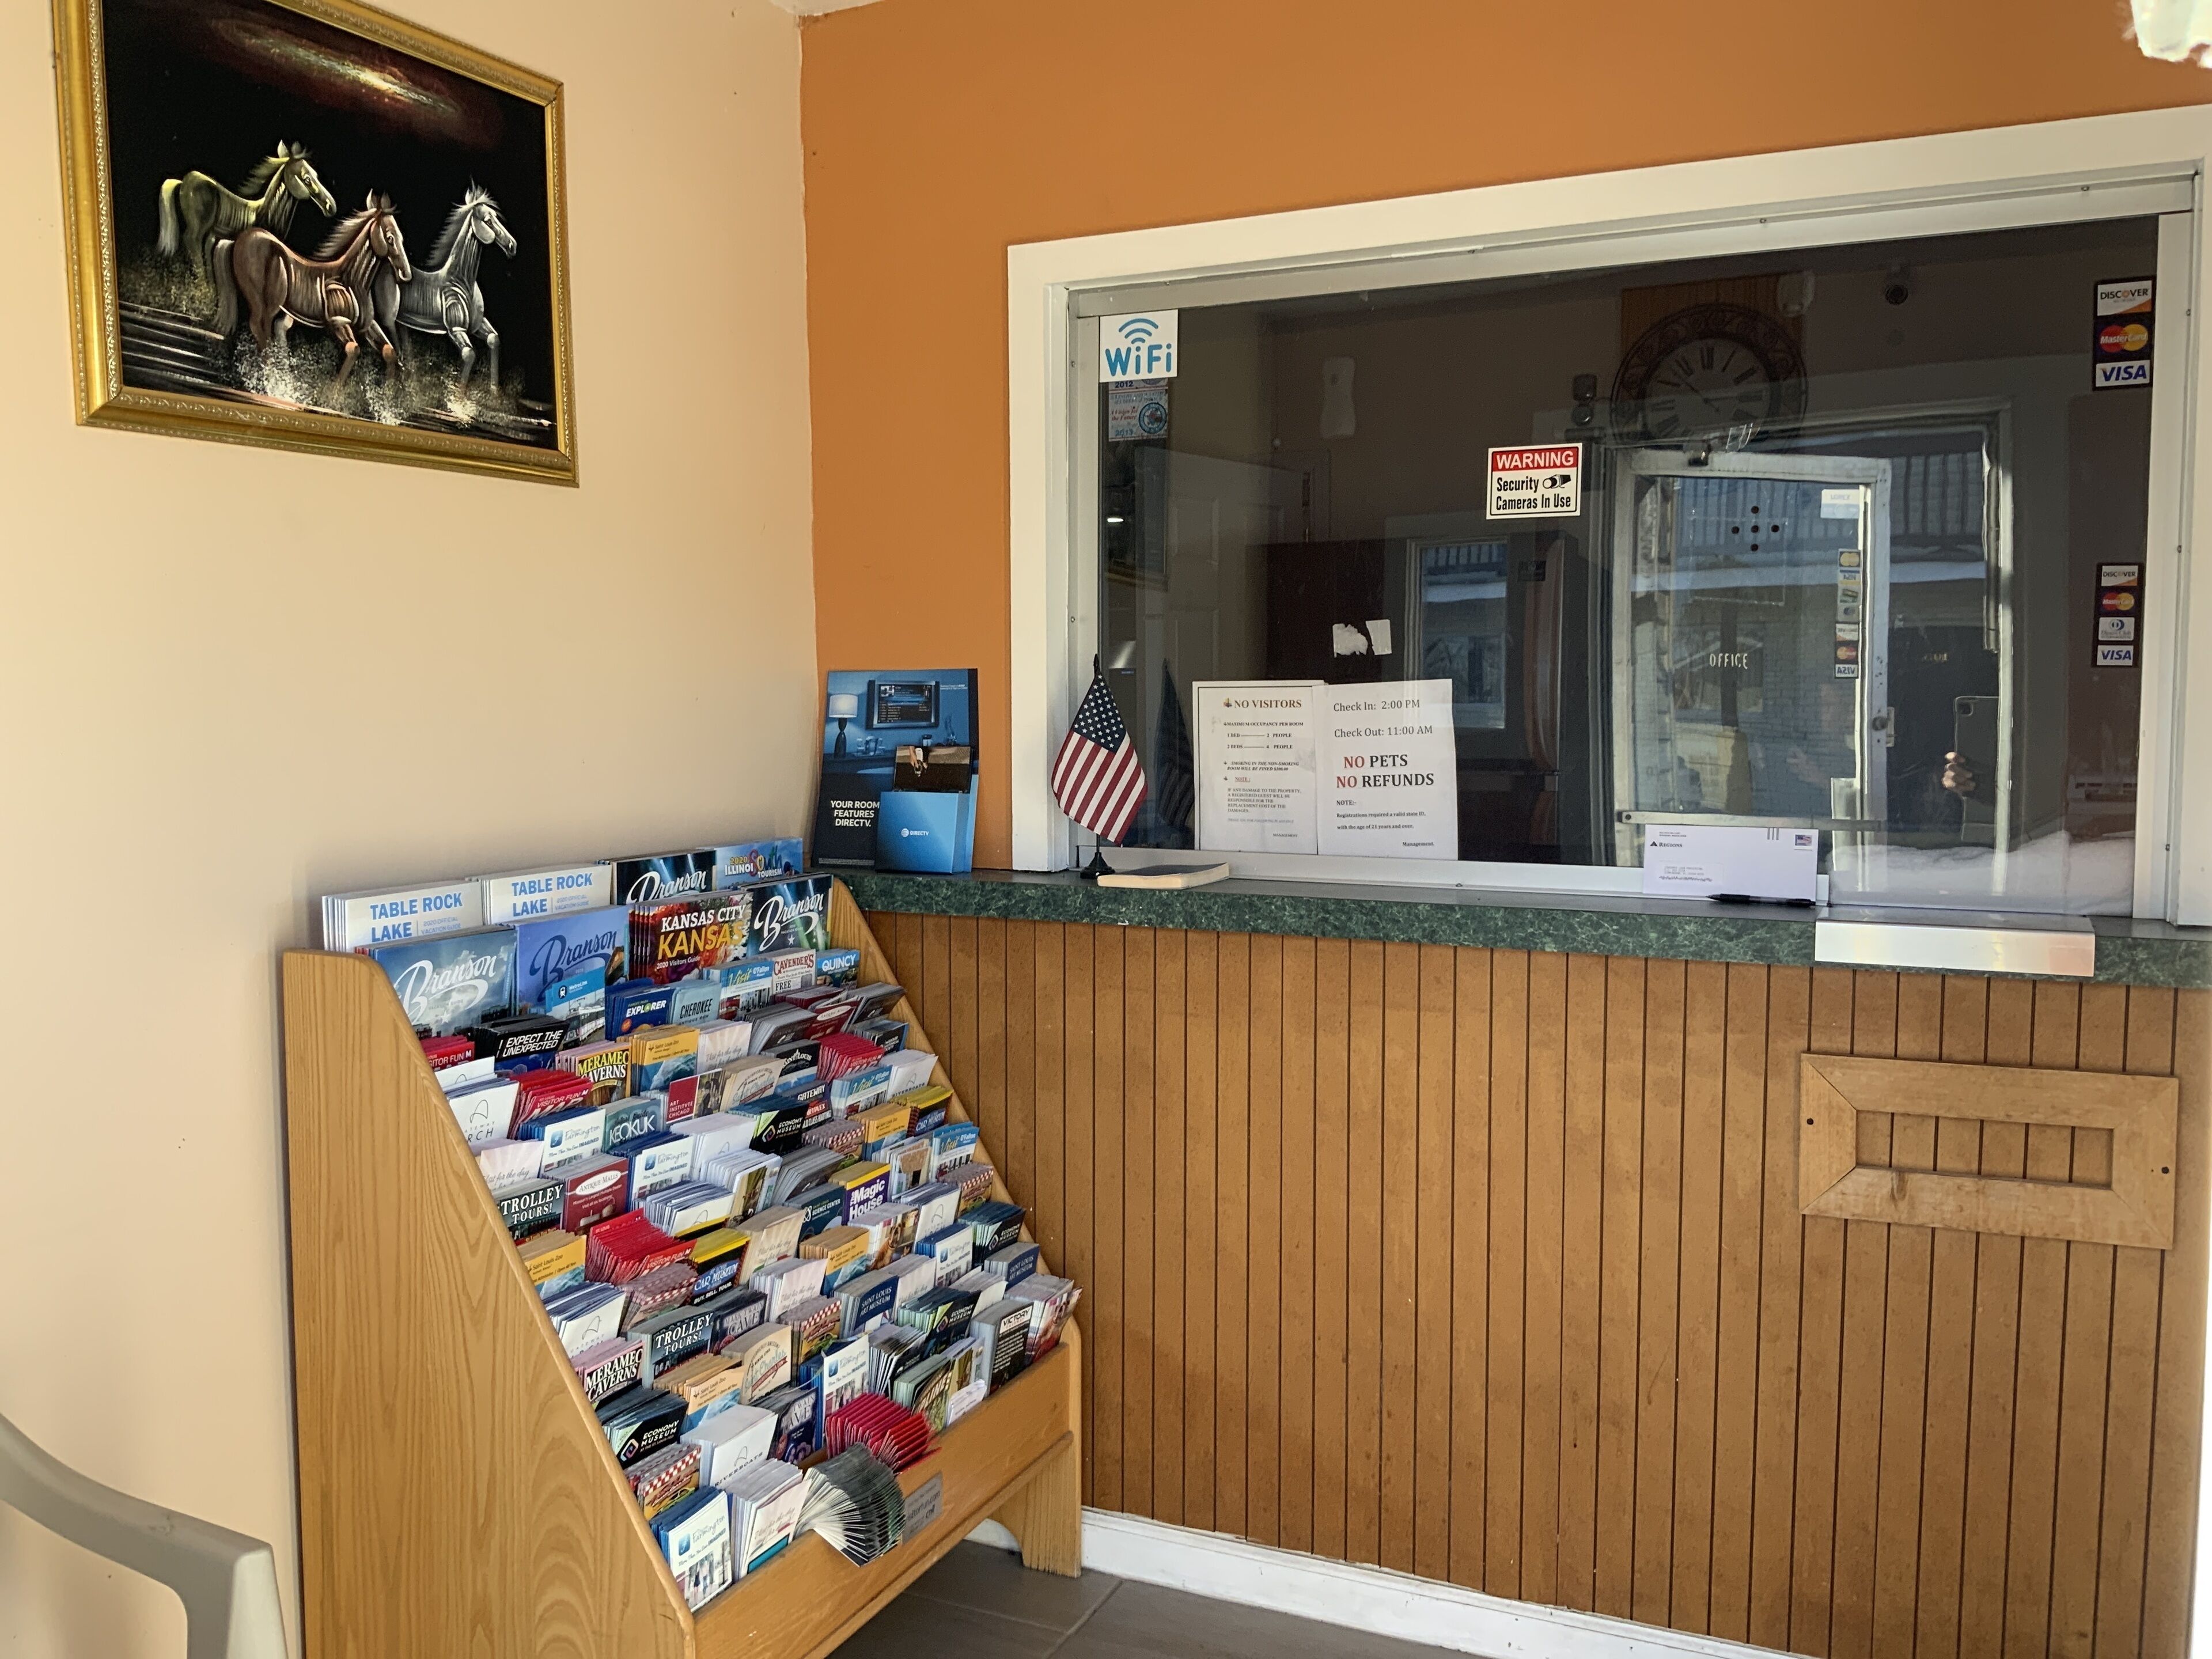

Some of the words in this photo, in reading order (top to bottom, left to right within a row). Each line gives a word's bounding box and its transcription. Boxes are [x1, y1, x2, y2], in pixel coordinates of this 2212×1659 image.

[2100, 289, 2149, 300] DISCOVER
[2100, 332, 2147, 344] MasterCard
[1105, 343, 1172, 376] WiFi
[2100, 365, 2147, 382] VISA
[1497, 451, 1574, 469] WARNING
[1497, 476, 1539, 493] Security
[1497, 496, 1537, 510] Cameras
[1541, 494, 1550, 508] In
[1554, 493, 1571, 507] Use
[1710, 653, 1748, 669] OFFICE
[2101, 650, 2131, 660] VISA
[1234, 700, 1249, 709] NO
[1252, 699, 1302, 709] VISITORS
[1334, 702, 1362, 711] Check
[1363, 702, 1376, 710] In:
[1381, 700, 1403, 710] 2:00
[1405, 699, 1420, 709] PM
[1334, 728, 1362, 738] Check
[1364, 727, 1384, 737] Out:
[1388, 726, 1414, 736] 11:00
[1416, 725, 1433, 734] AM
[1344, 755, 1365, 768] NO
[1369, 754, 1408, 767] PETS
[1336, 775, 1357, 788] NO
[1362, 773, 1434, 787] REFUNDS
[831, 801, 853, 809] YOUR
[855, 801, 880, 809] ROOM
[834, 810, 874, 818] FEATURES
[730, 857, 747, 865] 2020
[757, 868, 782, 878] TOURISM
[512, 878, 552, 896] TABLE
[557, 873, 593, 890] ROCK
[370, 899, 418, 920] TABLE
[423, 892, 463, 912] ROCK
[513, 898, 547, 916] LAKE
[437, 916, 458, 925] OFFICIAL
[661, 910, 715, 933] KANSAS
[718, 904, 746, 922] CITY
[753, 893, 824, 952] Branson
[372, 922, 412, 942] LAKE
[421, 925, 446, 934] VACATION
[658, 921, 743, 960] KANSAS
[529, 931, 617, 1002] Branson
[656, 961, 669, 969] 2020
[669, 958, 687, 967] Visitors
[774, 954, 814, 976] CAVENDER'S
[822, 954, 857, 972] QUINCY
[728, 968, 753, 987] Visit
[775, 980, 792, 991] FREE
[393, 956, 497, 1024] Branson
[680, 998, 713, 1018] CHEROKEE
[507, 1034, 542, 1048] EXPECT
[544, 1030, 563, 1039] THE
[502, 1040, 558, 1057] UNEXPECTED
[798, 1052, 812, 1062] LOUIS
[450, 1054, 464, 1062] FUN
[578, 1051, 630, 1075] MERAMEC
[798, 1085, 825, 1101] GATEWAY
[537, 1097, 563, 1108] VISITOR
[668, 1108, 690, 1118] CHICAGO
[609, 1115, 655, 1145] KEOKUK
[778, 1125, 801, 1134] MUSEUM
[779, 1118, 802, 1128] ECONOMY
[579, 1181, 601, 1192] ANTIQUE
[601, 1173, 619, 1184] MALLS
[855, 1179, 885, 1203] Magic
[501, 1184, 563, 1216] TROLLEY
[812, 1205, 827, 1216] SCIENCE
[827, 1199, 840, 1210] CENTER
[850, 1194, 884, 1221] House
[512, 1203, 552, 1224] TOURS!
[647, 1257, 671, 1268] VISITOR
[1009, 1262, 1021, 1272] SAINT
[1021, 1255, 1034, 1267] LOUIS
[695, 1277, 711, 1291] CAR
[711, 1263, 738, 1284] MUSEUM
[862, 1296, 876, 1308] SAINT
[876, 1286, 892, 1300] LOUIS
[859, 1306, 869, 1317] ART
[869, 1296, 890, 1312] MUSEUM
[952, 1304, 974, 1316] ECONOMY
[729, 1311, 760, 1335] CAVE
[949, 1310, 972, 1323] MUSEUM
[1003, 1309, 1030, 1326] VICTORY
[656, 1313, 713, 1349] TROLLEY
[664, 1331, 701, 1355] TOURS!
[586, 1349, 643, 1392] MERAMEC
[588, 1363, 638, 1402] CAVERNS
[641, 1427, 677, 1446] MUSEUM
[643, 1420, 679, 1440] ECONOMY
[714, 1451, 763, 1487] RIVERBOATS
[693, 1515, 725, 1544] Farmington
